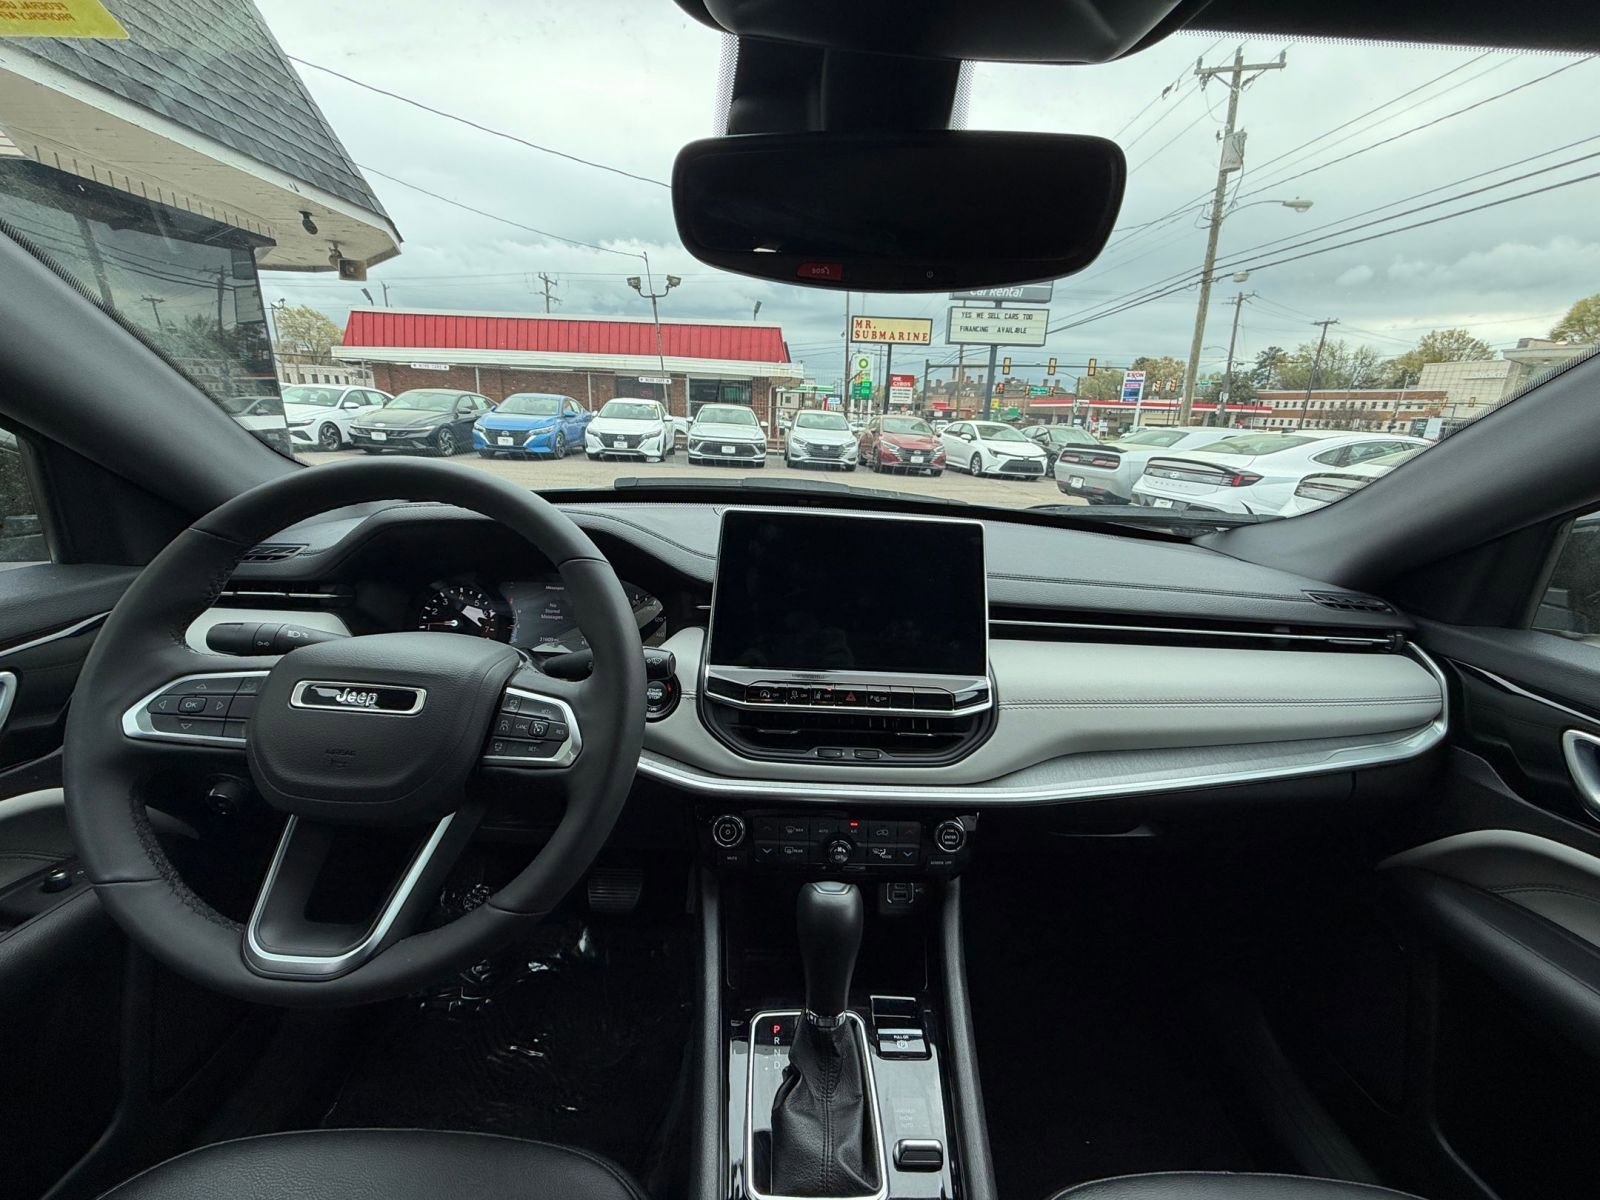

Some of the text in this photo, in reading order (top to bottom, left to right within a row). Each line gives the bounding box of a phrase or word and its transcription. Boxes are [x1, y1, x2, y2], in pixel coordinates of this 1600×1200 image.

[989, 287, 1024, 297] Rental
[961, 311, 972, 319] YES
[855, 319, 877, 330] MR.
[960, 325, 1027, 334] FINANCING AVAILABLE
[854, 330, 928, 342] SUBMARINE
[442, 598, 449, 606] 3
[474, 599, 480, 607] 5
[431, 607, 439, 615] 2
[484, 625, 490, 633] 7
[335, 688, 378, 706] Jeep
[185, 701, 198, 709] OK
[773, 1025, 781, 1034] P
[774, 1036, 780, 1045] R
[774, 1048, 781, 1057] N
[774, 1060, 781, 1069] D
